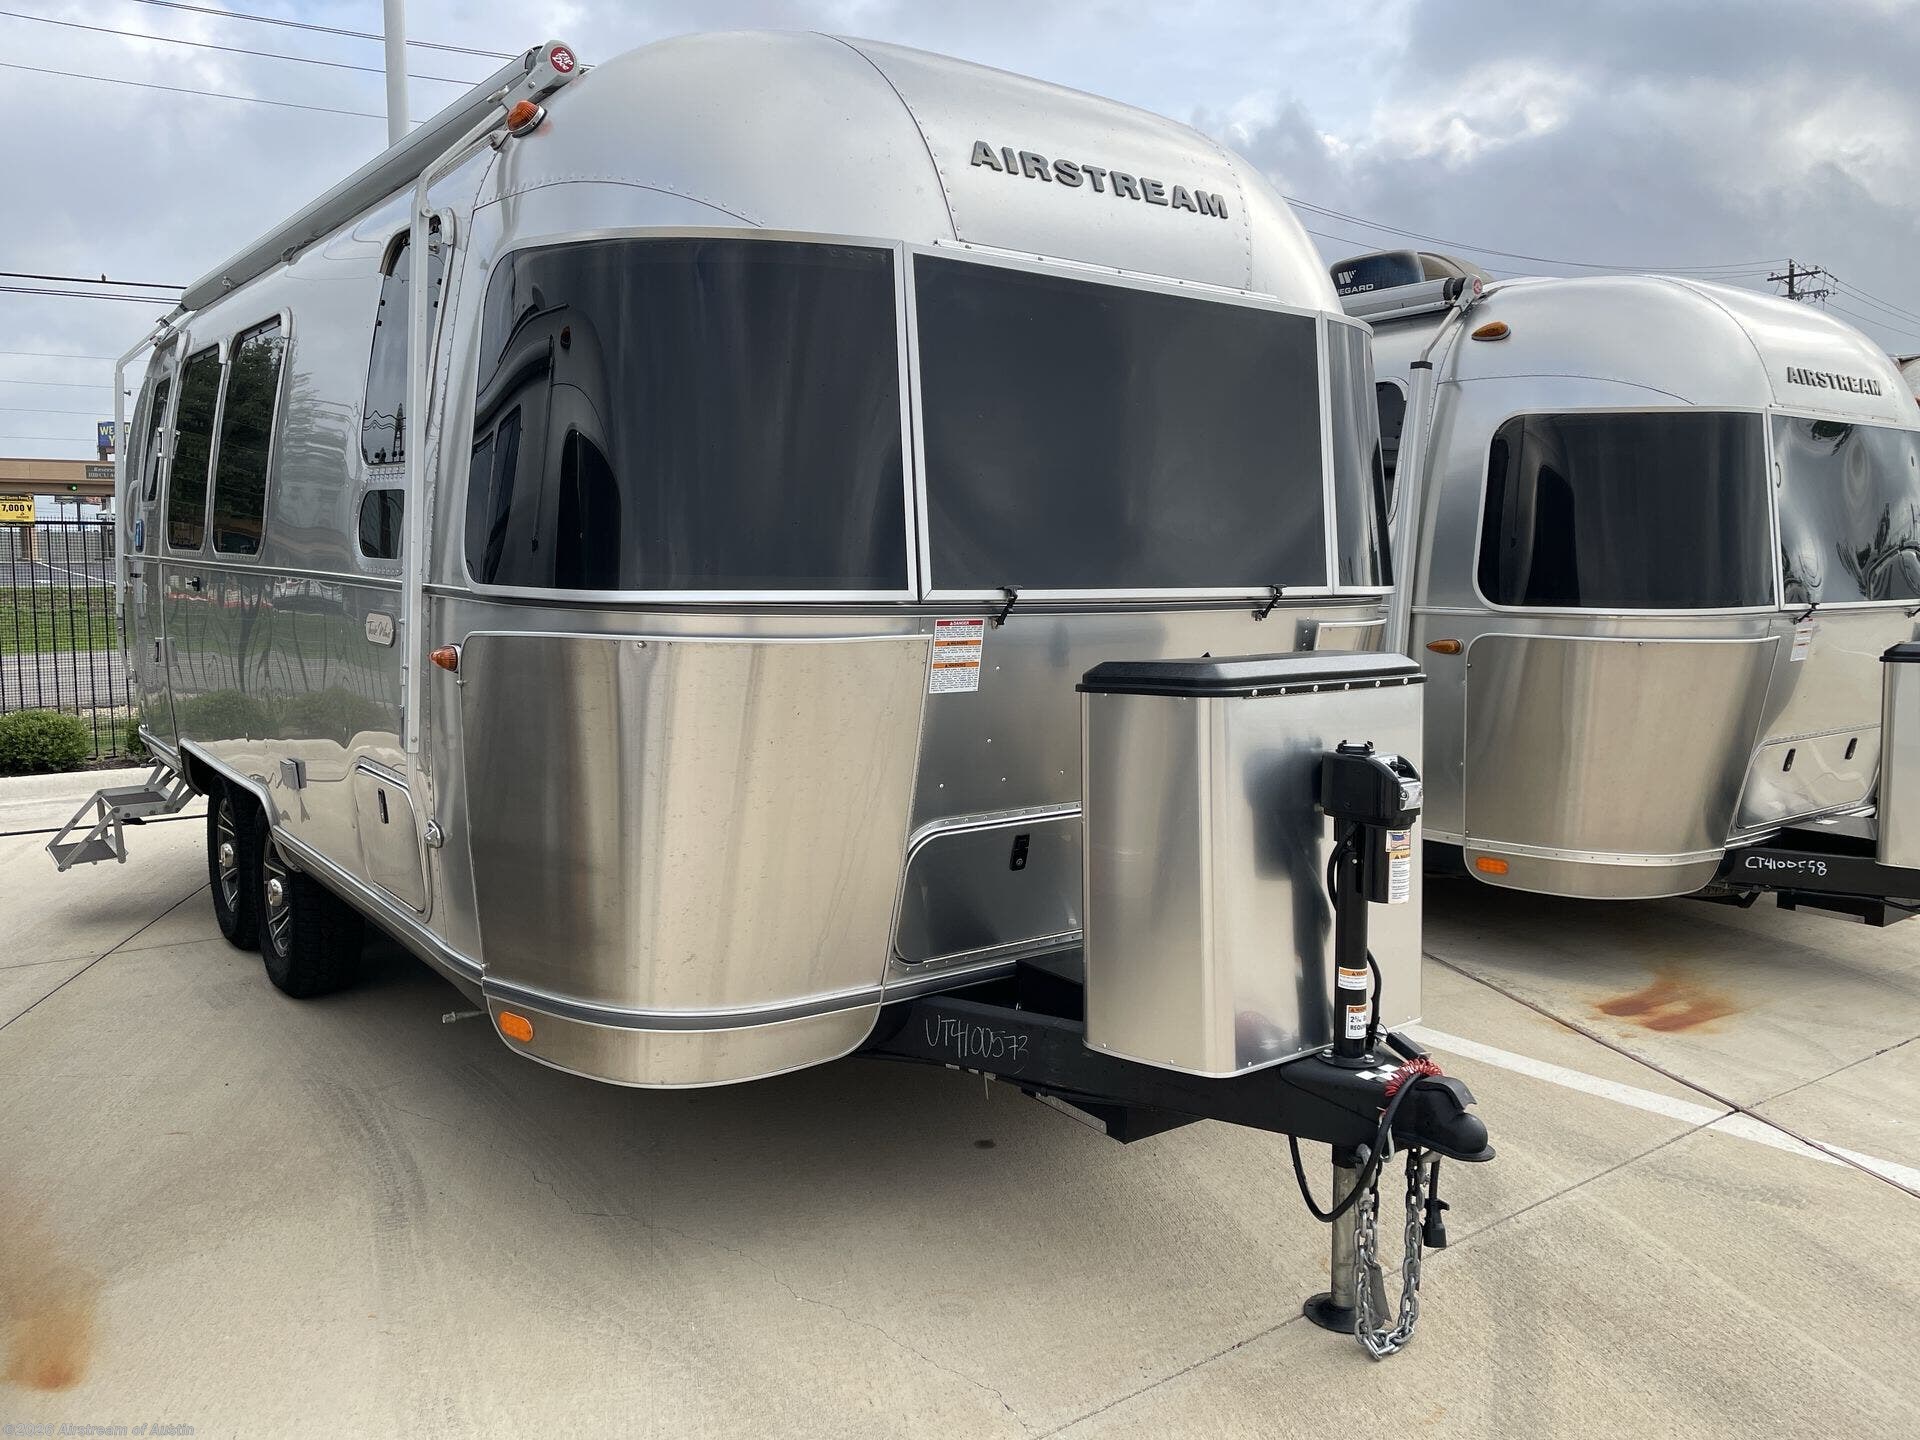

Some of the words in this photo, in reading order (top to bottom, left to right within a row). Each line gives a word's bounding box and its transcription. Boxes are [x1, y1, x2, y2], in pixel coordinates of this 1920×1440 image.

[971, 140, 1229, 219] AIRSTREAM
[1338, 283, 1374, 295] EGARD
[1786, 366, 1882, 396] AIRSTREAM
[1, 504, 25, 512] 7,000
[27, 504, 32, 512] V
